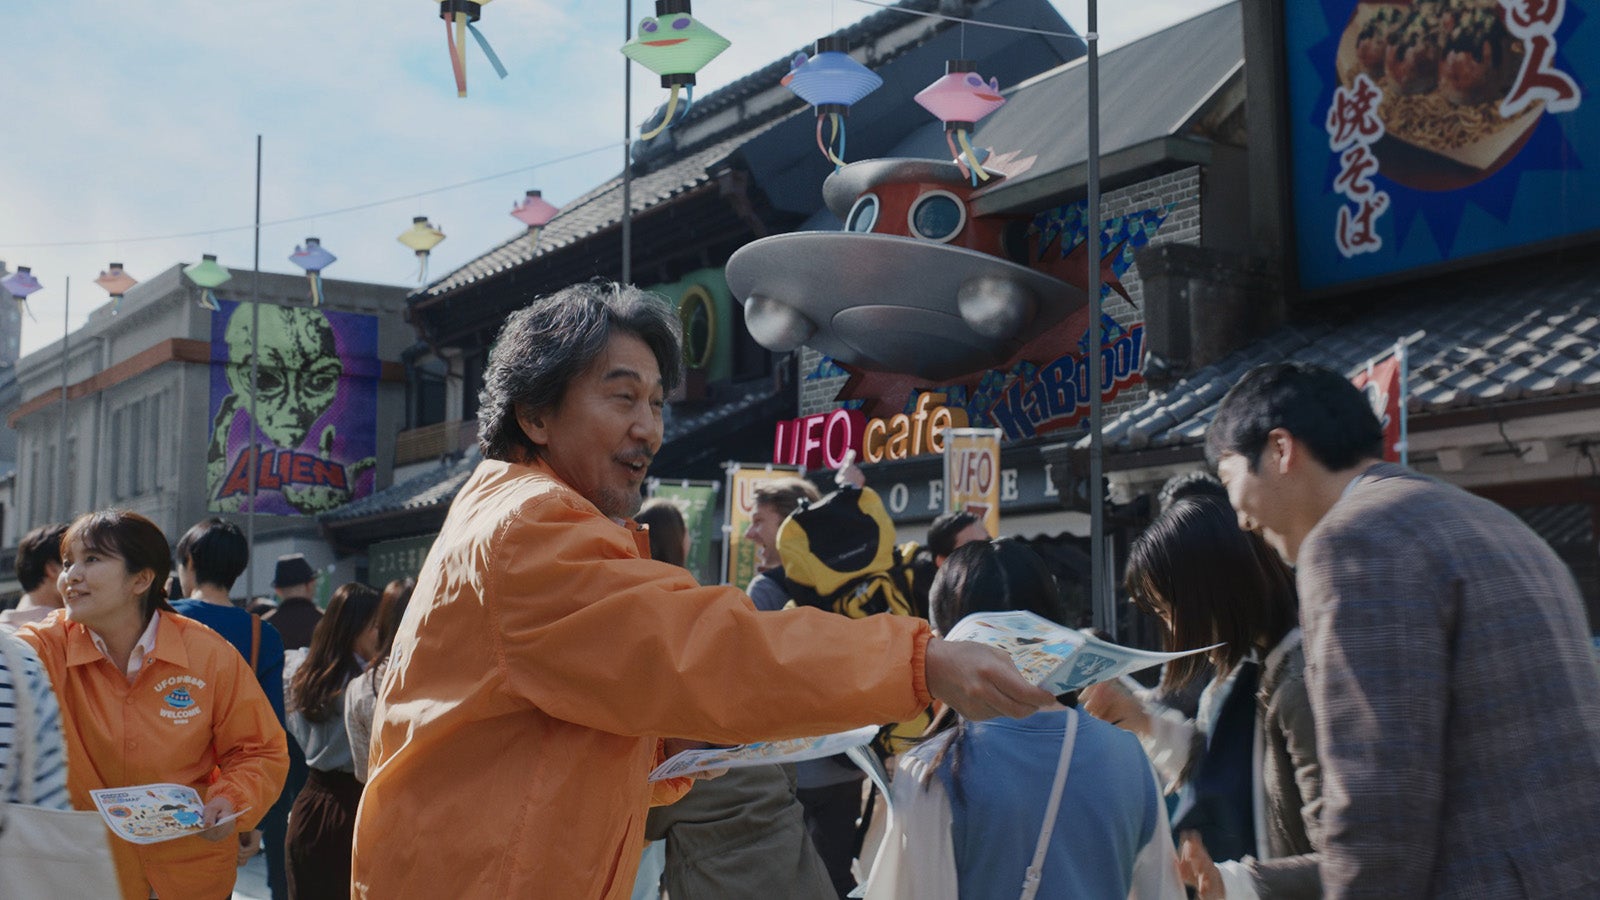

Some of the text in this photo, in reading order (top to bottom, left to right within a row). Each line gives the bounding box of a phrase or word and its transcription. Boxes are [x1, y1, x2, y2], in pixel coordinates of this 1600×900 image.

[774, 391, 952, 470] UFO cafe
[217, 444, 348, 499] ALIEN
[952, 450, 993, 495] UFO
[160, 706, 201, 718] WELCOME
